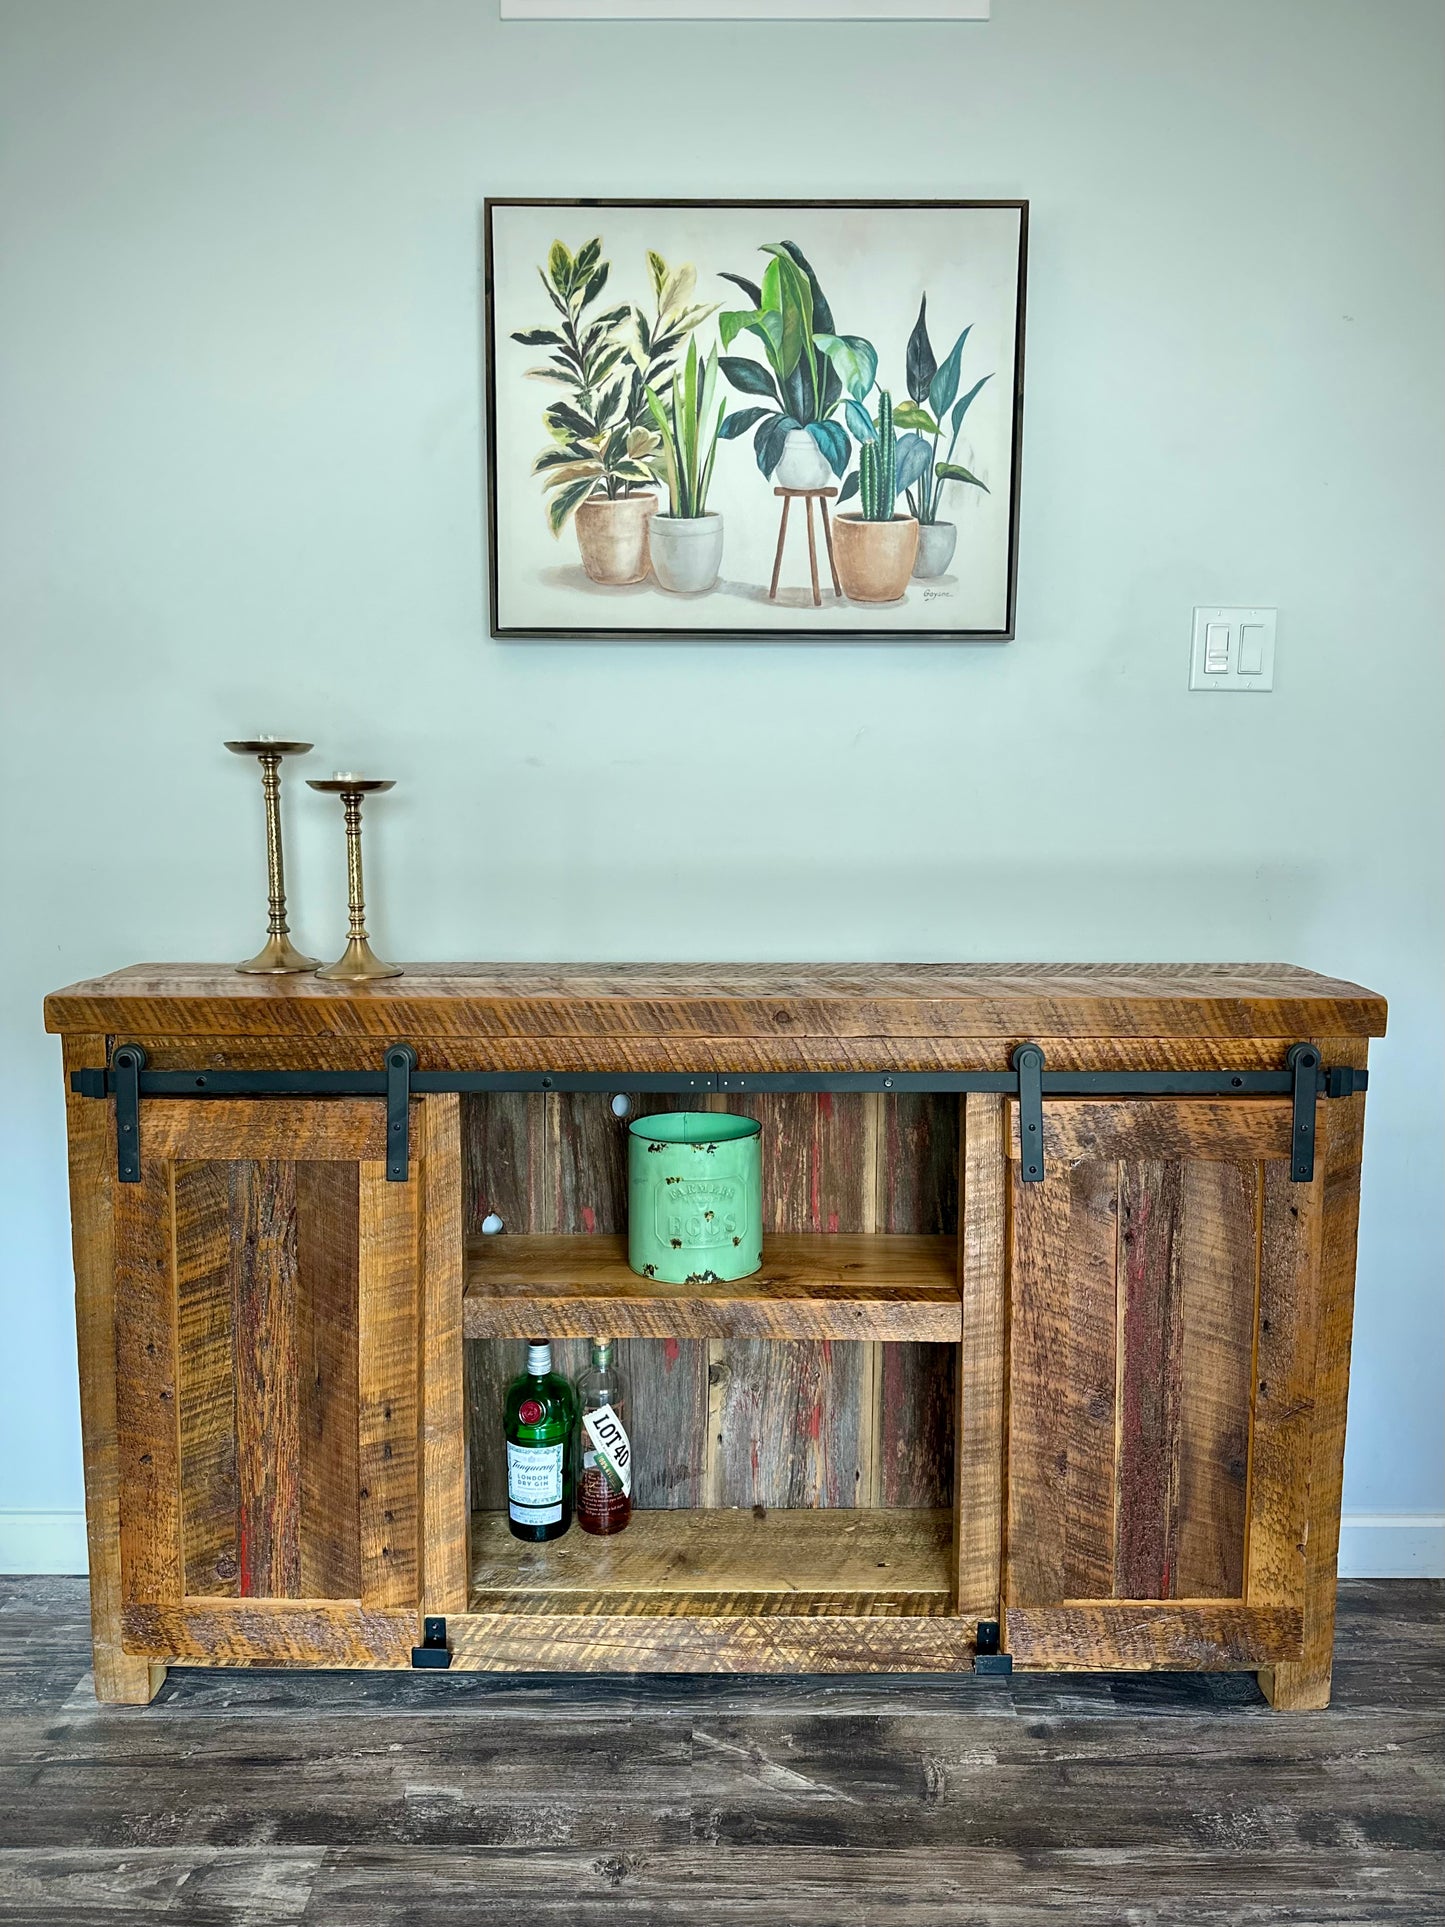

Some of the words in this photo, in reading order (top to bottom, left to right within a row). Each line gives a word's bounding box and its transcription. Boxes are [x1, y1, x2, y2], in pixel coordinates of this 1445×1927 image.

[668, 1212, 736, 1236] EGGS
[593, 1413, 622, 1447] LOT
[614, 1445, 629, 1467] 40
[512, 1459, 555, 1473] Tanqueray
[517, 1473, 549, 1481] LONDON
[517, 1479, 531, 1487] DRY
